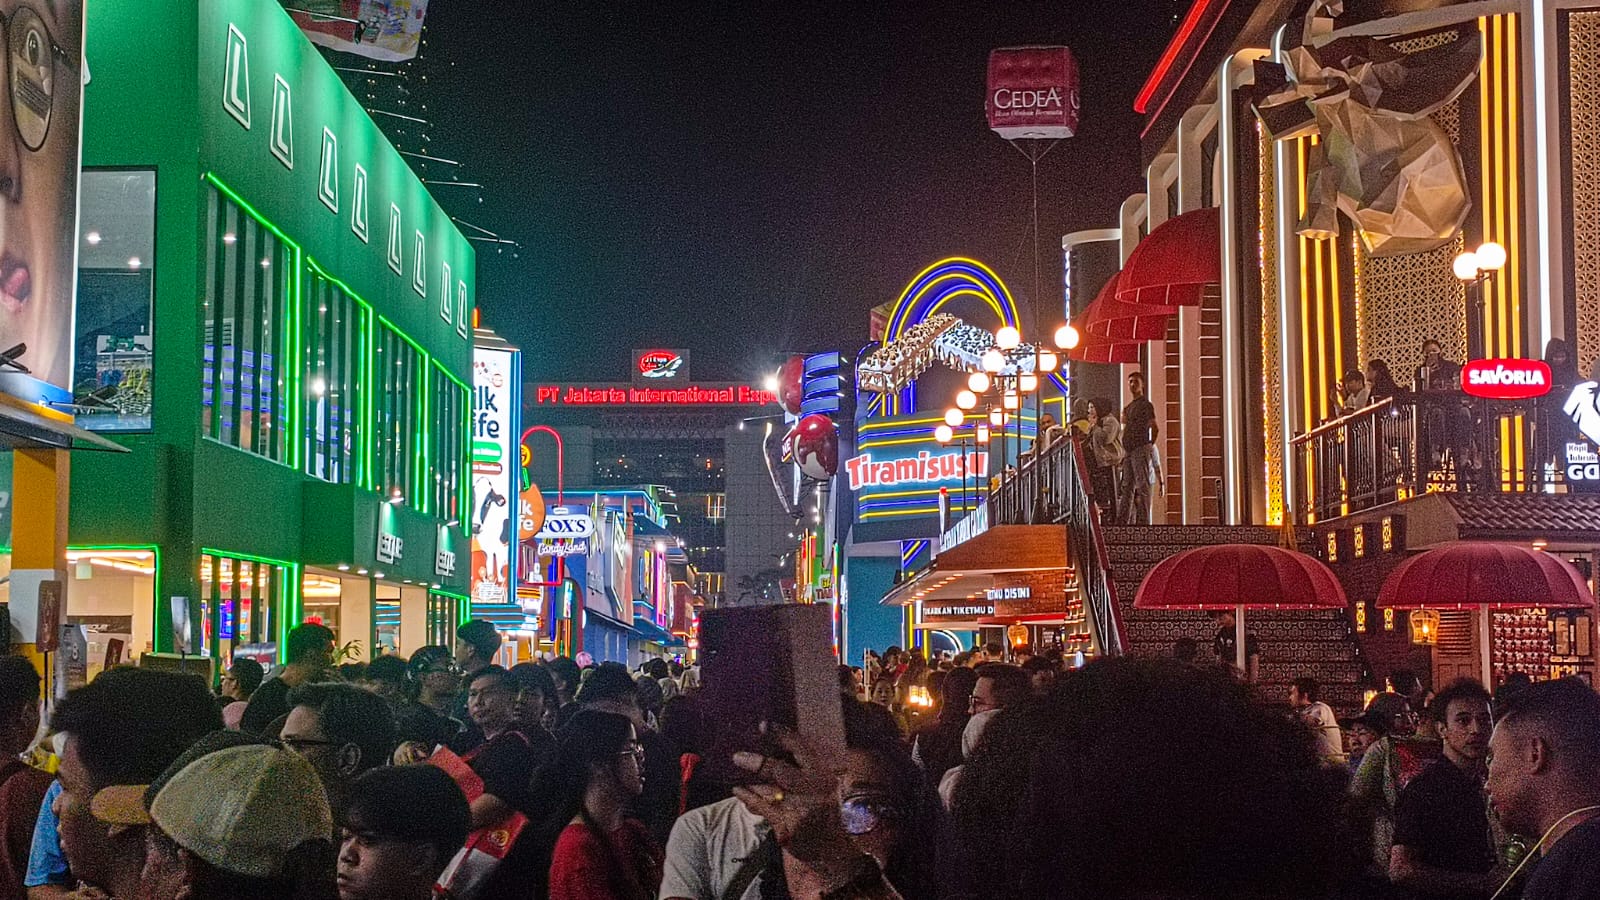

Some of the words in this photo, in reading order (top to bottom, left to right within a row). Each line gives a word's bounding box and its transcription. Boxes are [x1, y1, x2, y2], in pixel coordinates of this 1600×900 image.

[993, 87, 1062, 109] CEDEA
[1469, 364, 1545, 385] SAVORIA
[538, 386, 559, 404] PT
[563, 386, 626, 404] Jakarta
[629, 386, 734, 404] International
[846, 451, 987, 489] Tiramisusu
[1004, 587, 1030, 600] DISINI
[953, 606, 986, 615] TIKETMU
